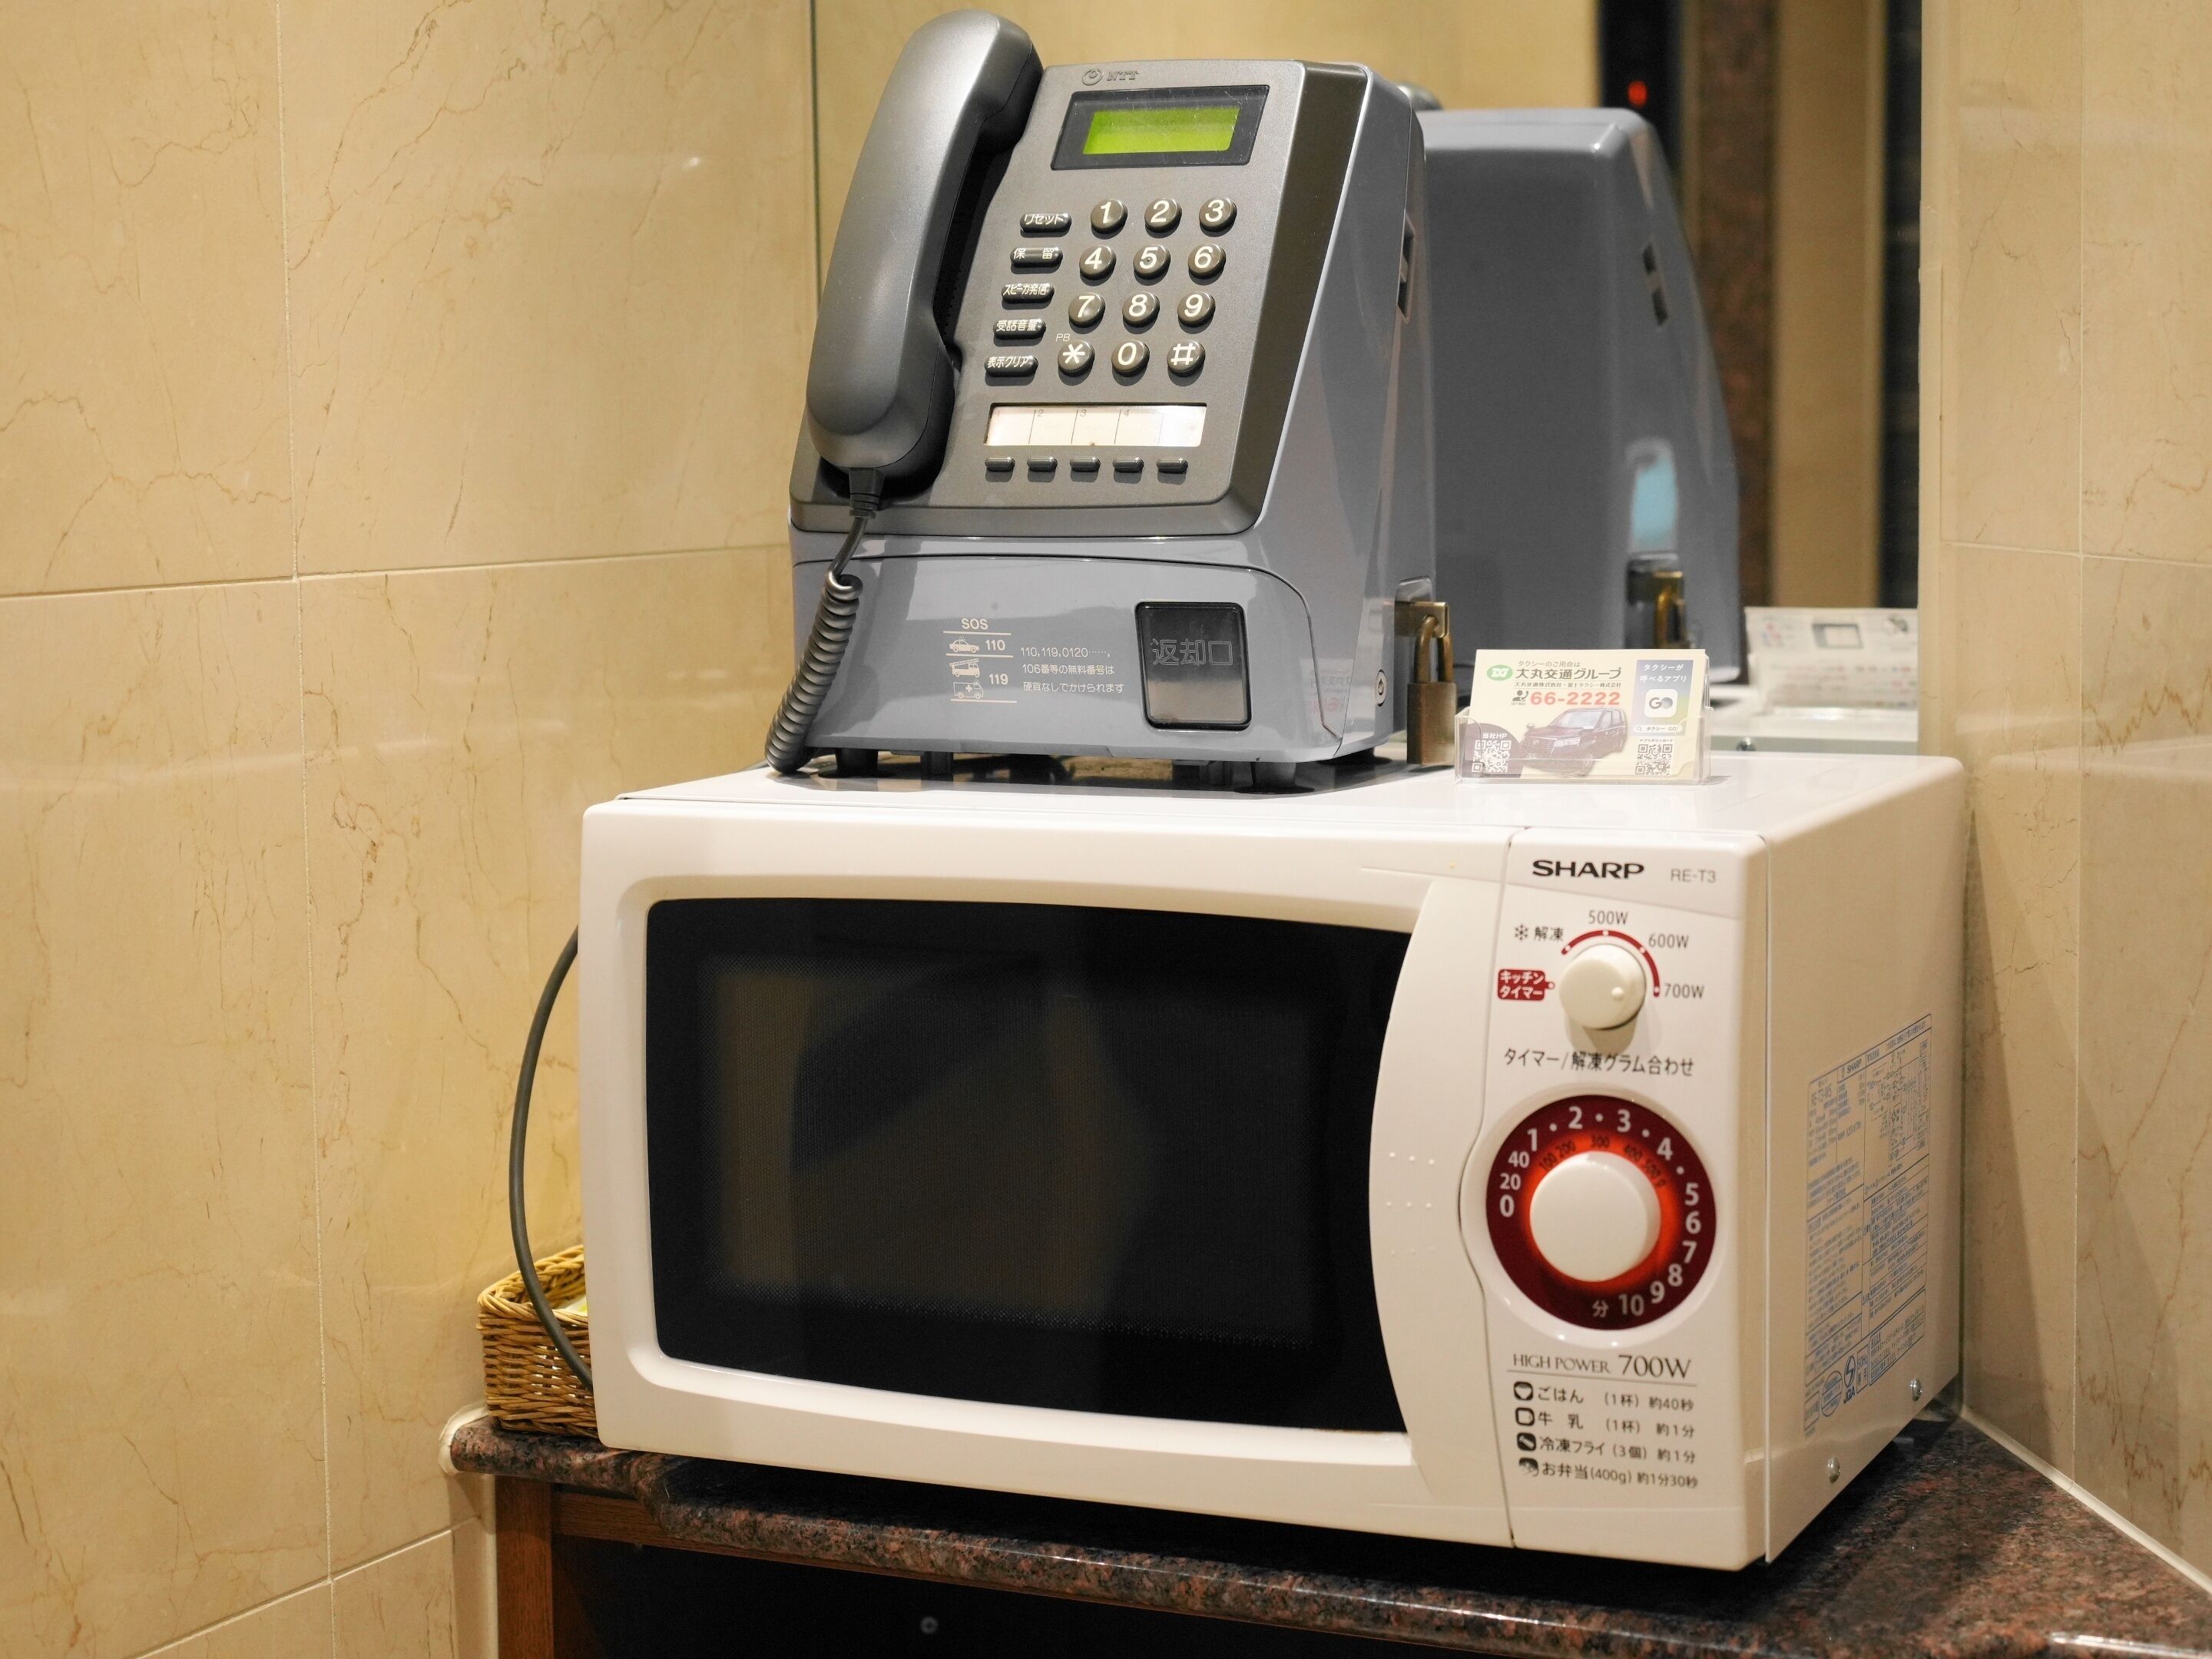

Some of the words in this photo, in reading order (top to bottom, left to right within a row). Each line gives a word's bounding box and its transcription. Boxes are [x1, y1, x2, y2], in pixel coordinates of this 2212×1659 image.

[1024, 214, 1065, 225] リセット
[1100, 201, 1112, 224] 1
[1151, 200, 1170, 223] 2
[1205, 200, 1224, 222] 3
[1084, 247, 1102, 270] 4
[1140, 247, 1158, 270] 5
[1194, 247, 1212, 269] 6
[1003, 283, 1047, 296] スピーカ発信
[1078, 295, 1095, 317] 7
[1129, 294, 1147, 316] 8
[1184, 293, 1203, 316] 9
[996, 320, 1038, 332] 受話音量
[1055, 333, 1071, 342] PB
[987, 356, 1029, 368] 表示クリア
[1118, 343, 1137, 366] 0
[1171, 343, 1196, 366] #
[962, 618, 988, 630] SOS
[985, 639, 1005, 651] 110
[1152, 638, 1233, 667] 返却口
[1022, 664, 1115, 675] 106番等の無料番号は
[1515, 667, 1621, 680] 大丸交通グループ
[988, 674, 1008, 685] 119
[1023, 681, 1124, 694] 硬貨なしでかけられます
[1530, 691, 1621, 705] 66-2222
[1532, 859, 1644, 879] SHARP
[1671, 869, 1717, 883] RE-T3
[1588, 910, 1628, 925] 500W
[1535, 926, 1564, 942] 解凍
[1648, 934, 1689, 949] 600W
[1500, 971, 1545, 984] キッチン
[1500, 985, 1543, 999] タイマー
[1664, 984, 1705, 999] 700W
[1846, 1059, 1862, 1074] SHARP
[1568, 1106, 1583, 1129] 2
[1617, 1109, 1631, 1133] 3
[1527, 1128, 1538, 1151] 1
[1656, 1137, 1673, 1161] 4
[1508, 1151, 1530, 1168] 40
[1499, 1172, 1522, 1190] 20
[1684, 1182, 1699, 1206] 5
[1499, 1194, 1515, 1217] 0
[1685, 1211, 1701, 1234] 6
[1682, 1240, 1697, 1263] 7
[1667, 1263, 1683, 1287] 8
[1651, 1281, 1665, 1304] 9
[1592, 1300, 1609, 1318] 分
[1619, 1293, 1644, 1316] 10
[1512, 1353, 1551, 1369] HIGH
[1555, 1356, 1611, 1374] POWER
[1618, 1354, 1691, 1379] 700W
[1538, 1386, 1584, 1404] ごはん
[1648, 1396, 1694, 1412] 約40秒
[1844, 1385, 1856, 1405] JQA
[1539, 1436, 1606, 1456] 冷凍フライ
